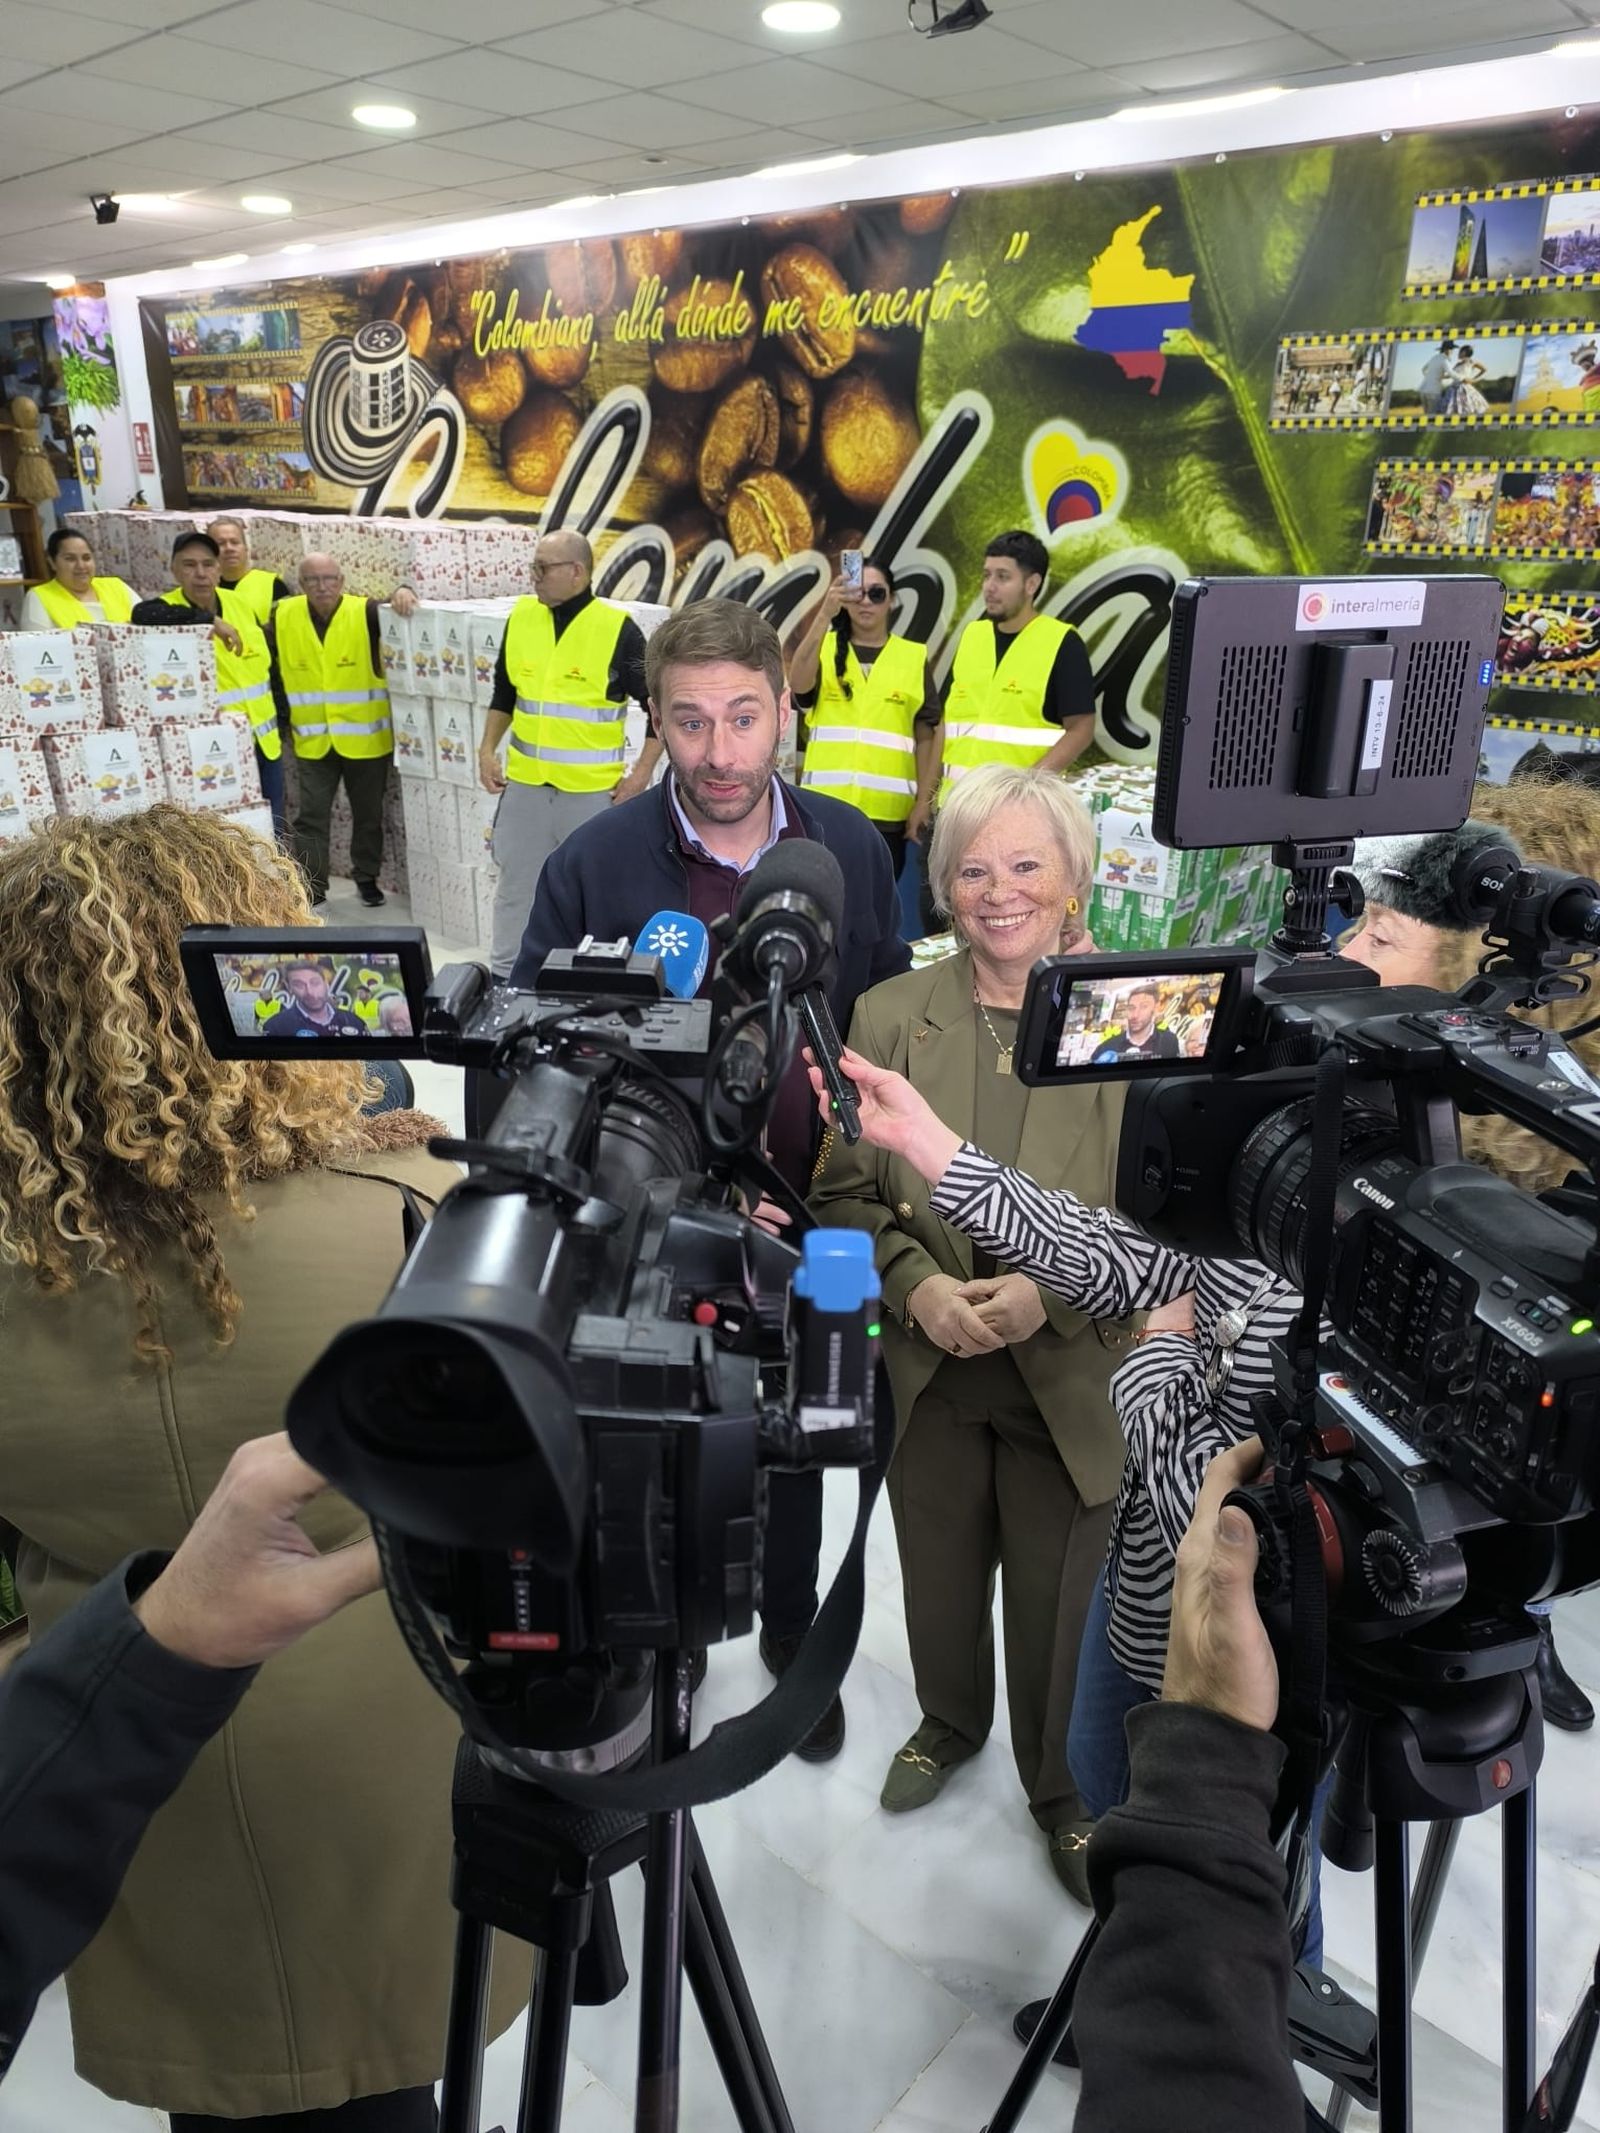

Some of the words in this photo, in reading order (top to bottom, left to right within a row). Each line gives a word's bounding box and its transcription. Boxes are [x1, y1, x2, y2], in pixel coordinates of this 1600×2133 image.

[614, 274, 666, 343] allá
[676, 270, 750, 341] dónde
[763, 295, 804, 338] me
[1331, 598, 1421, 615] interalmería
[1353, 1177, 1396, 1211] Canon
[1501, 1316, 1544, 1348] XF605
